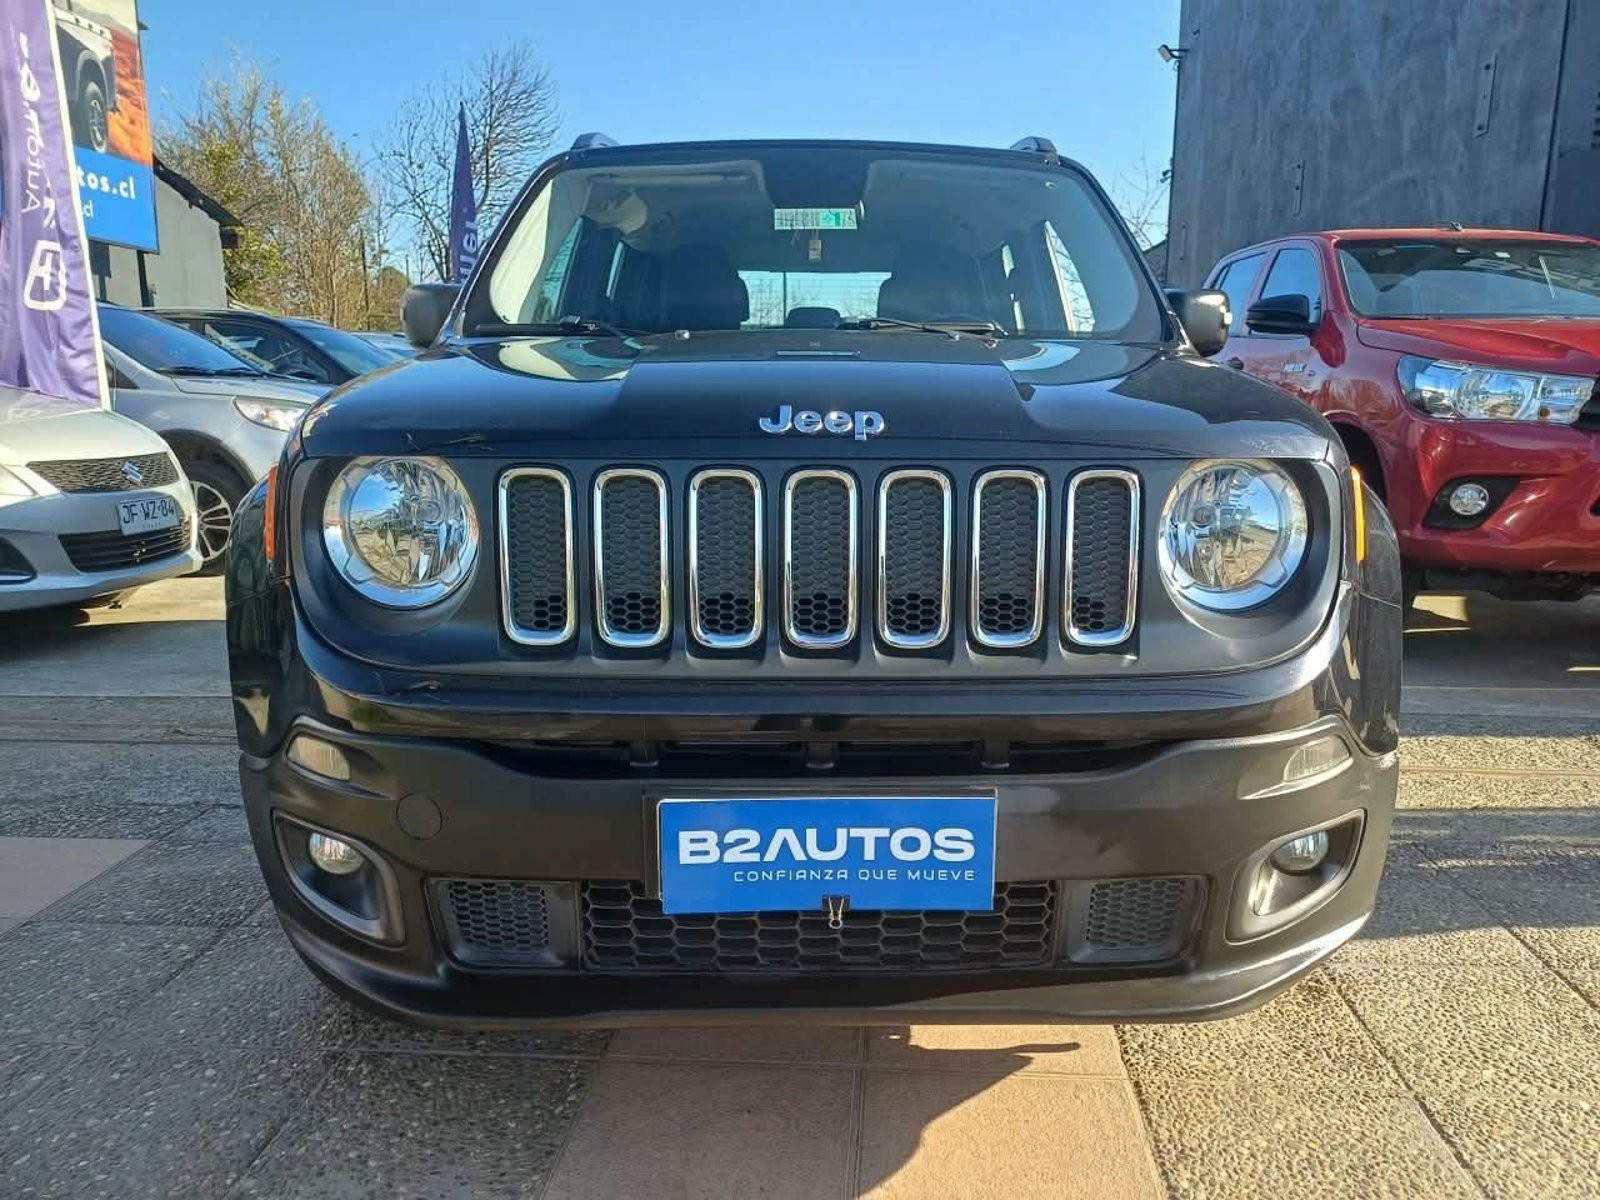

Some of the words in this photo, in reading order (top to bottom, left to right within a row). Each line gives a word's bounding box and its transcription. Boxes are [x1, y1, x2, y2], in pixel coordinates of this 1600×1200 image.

[77, 165, 136, 199] tos.cl
[759, 404, 885, 440] Jeep
[678, 827, 976, 865] B2AUTOS
[733, 869, 848, 882] CONFIANZA
[858, 869, 898, 880] QUE
[907, 869, 976, 881] MUEVE
